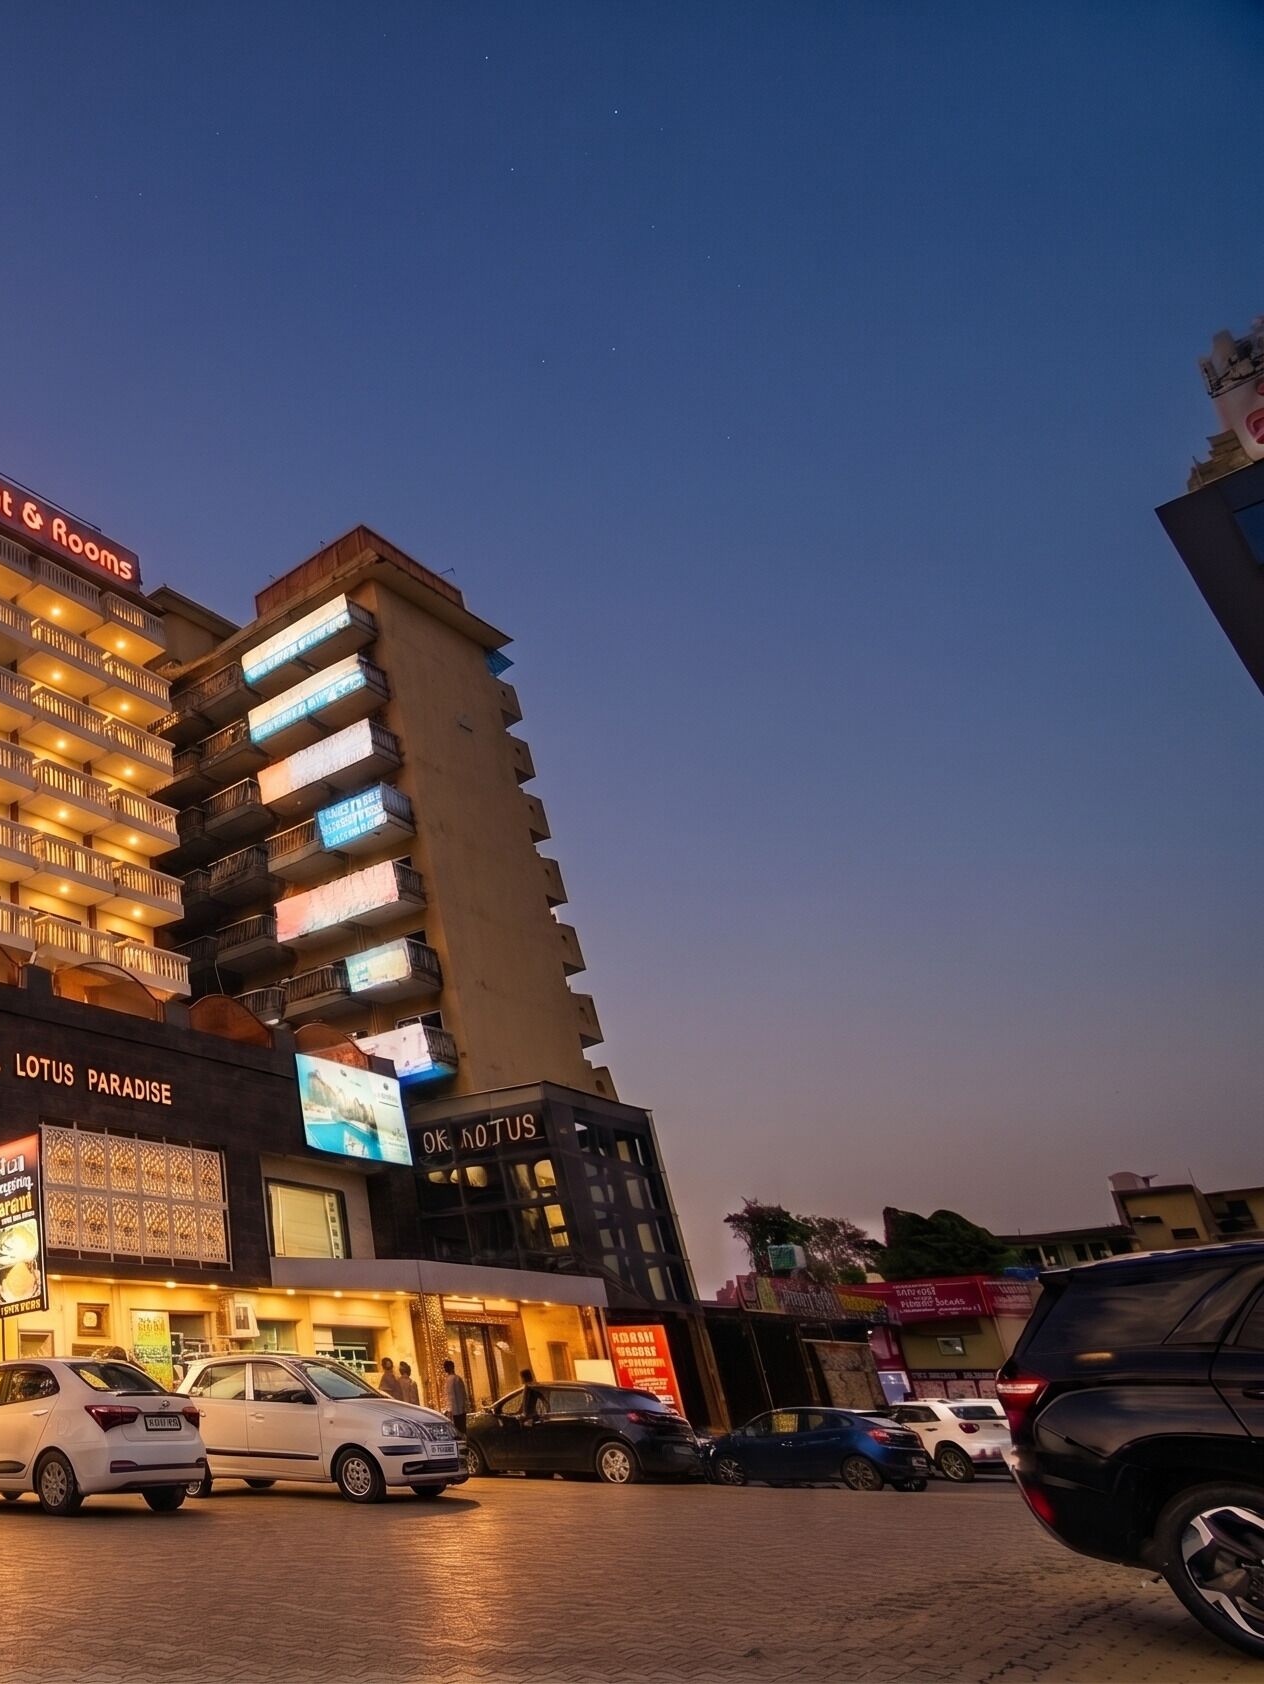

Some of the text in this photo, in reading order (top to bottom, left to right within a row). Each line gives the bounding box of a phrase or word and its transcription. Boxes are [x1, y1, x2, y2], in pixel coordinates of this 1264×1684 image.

[22, 501, 45, 531] &
[52, 517, 134, 582] Rooms
[16, 1053, 75, 1087] LOTUS
[88, 1069, 173, 1105] PARADISE
